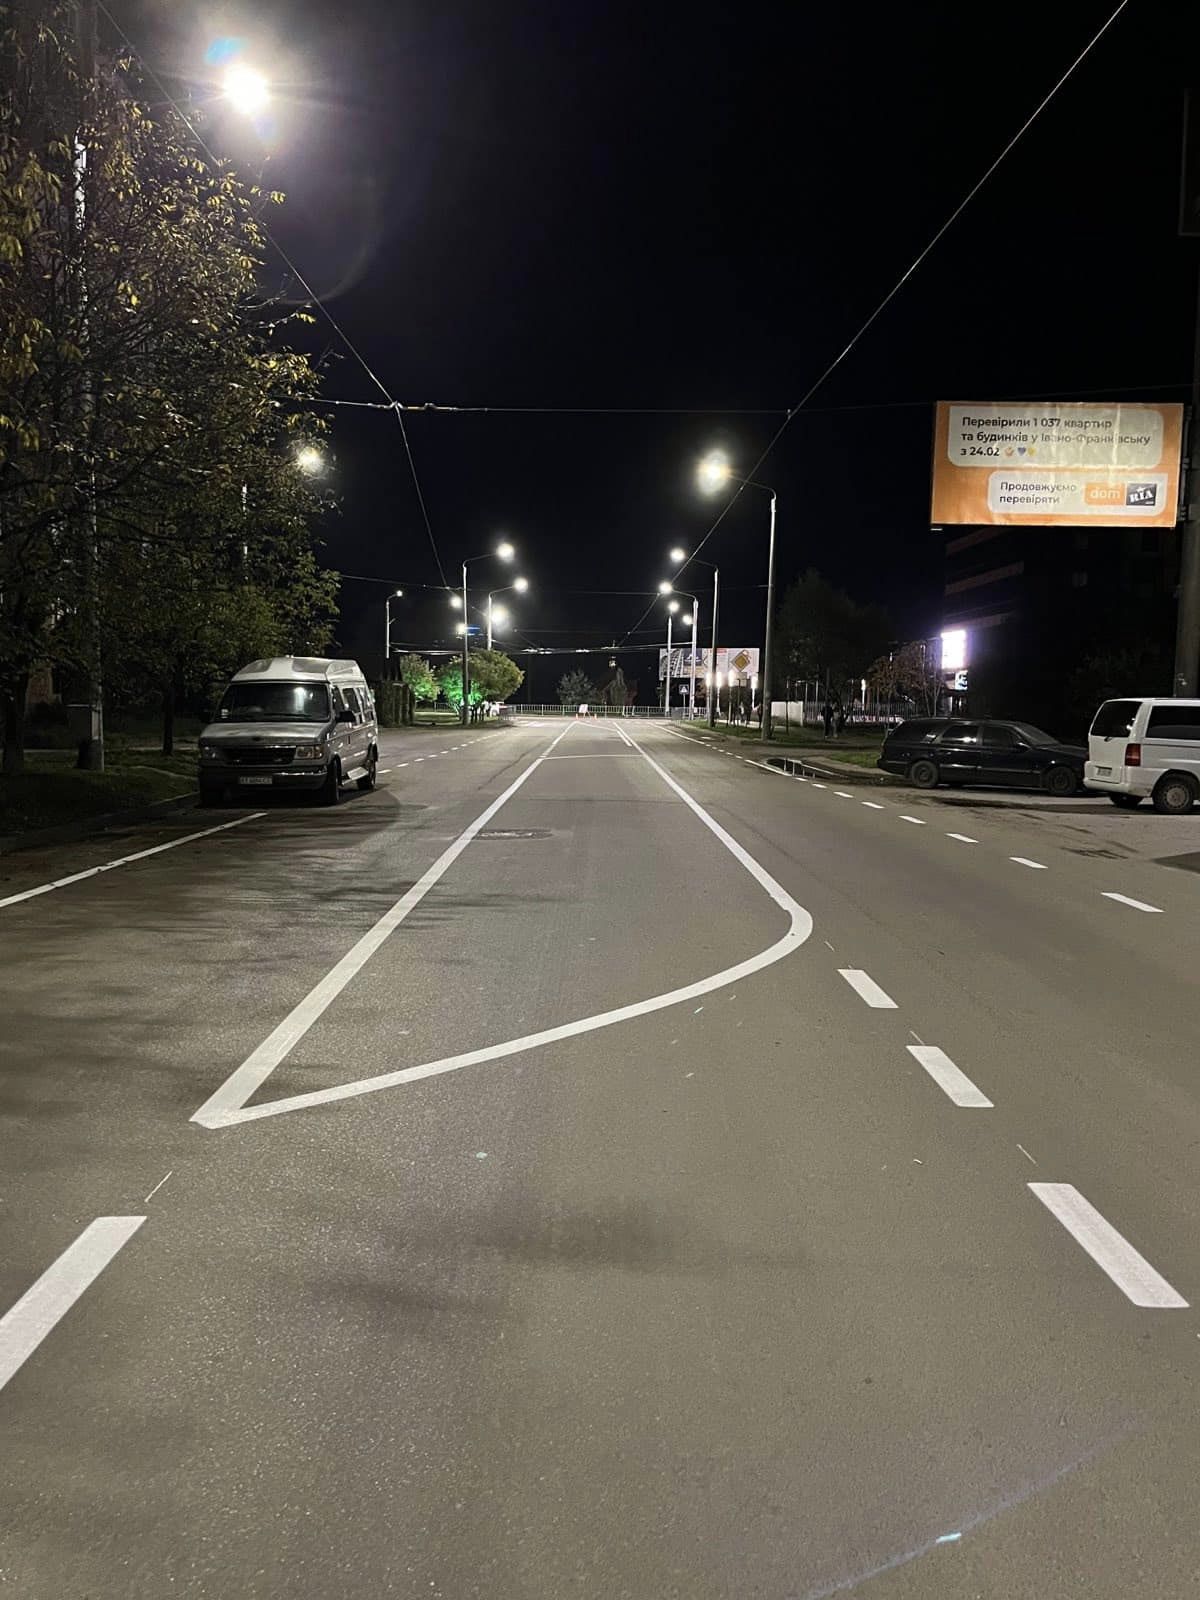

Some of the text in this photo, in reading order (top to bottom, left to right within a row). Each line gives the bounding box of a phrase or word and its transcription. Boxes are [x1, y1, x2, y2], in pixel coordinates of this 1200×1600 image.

[962, 416, 1112, 430] Перевірили 1 037 квартир
[961, 431, 1151, 446] та будинків у Івно-Франквську
[960, 446, 1000, 456] з 24.02
[1000, 481, 1077, 493] Продовжуємо
[999, 494, 1060, 504] перевіряти
[1090, 487, 1154, 503] dom RIA
